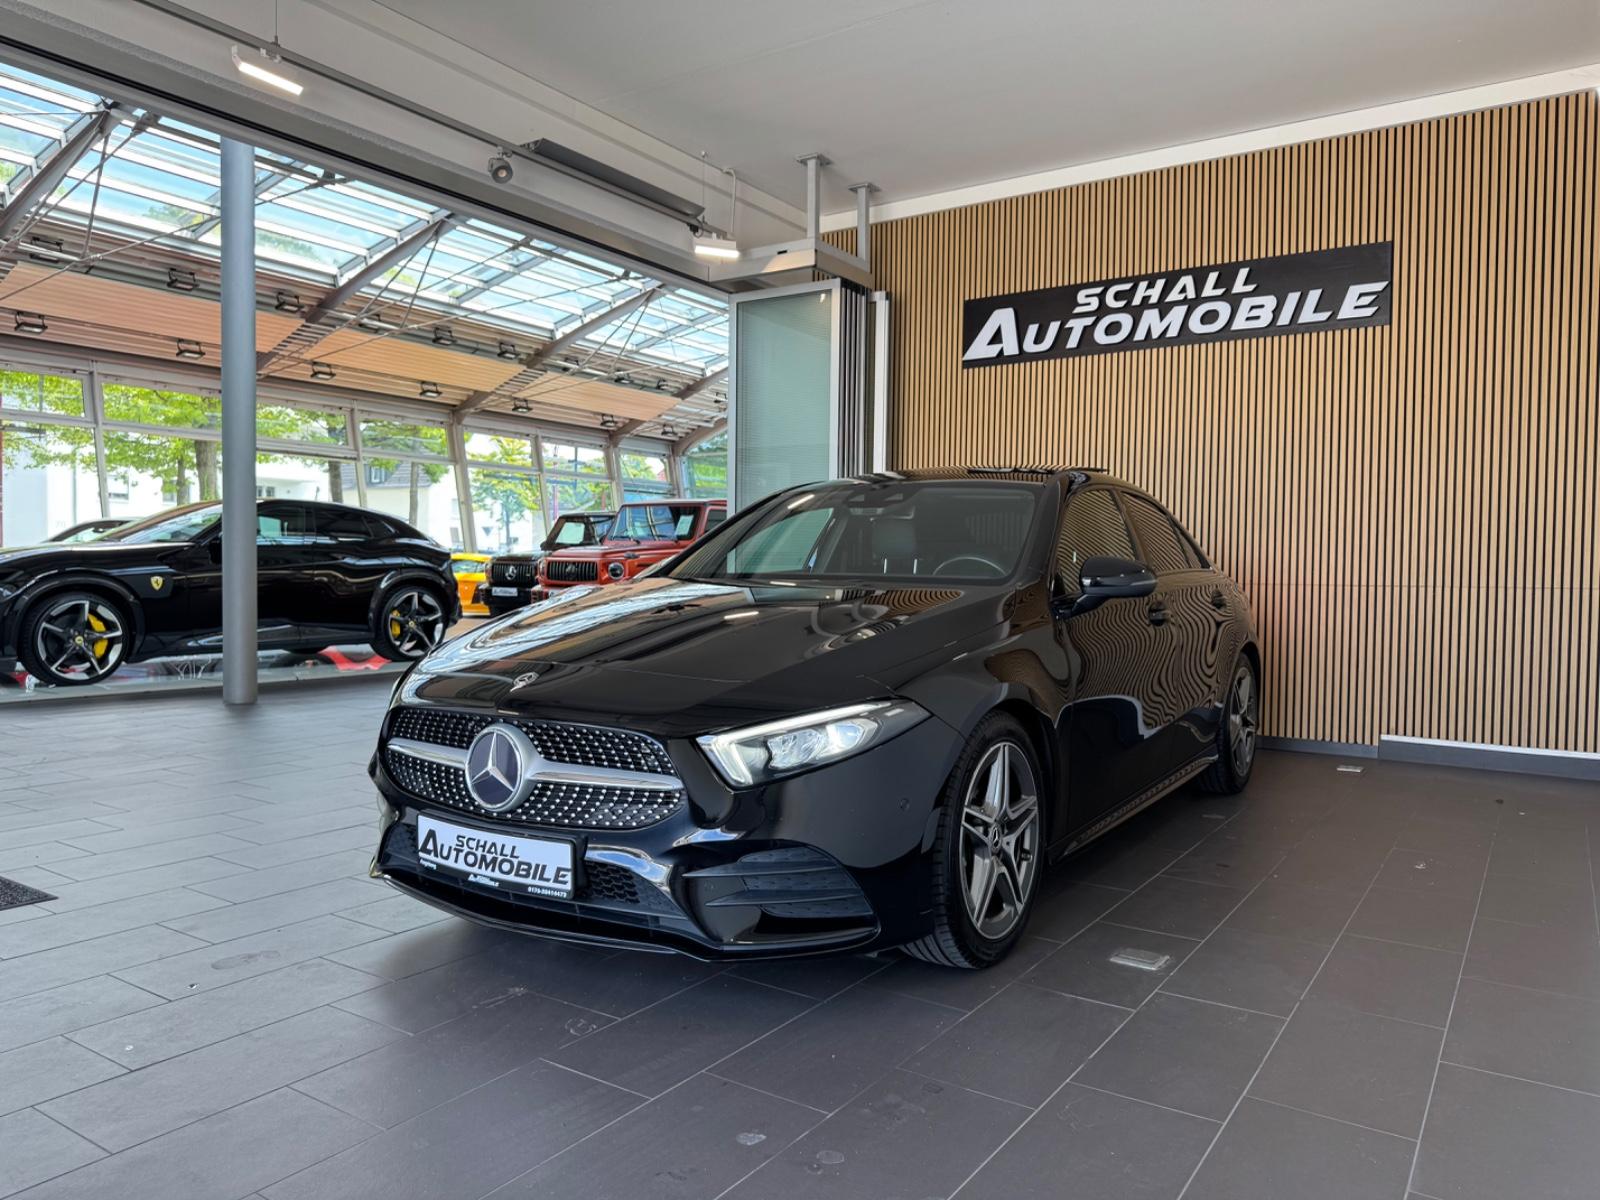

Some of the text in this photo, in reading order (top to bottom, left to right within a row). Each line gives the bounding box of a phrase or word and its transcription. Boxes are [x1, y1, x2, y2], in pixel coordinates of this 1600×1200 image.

[1073, 267, 1257, 314] SCHALL
[962, 280, 1389, 361] AUTOMOBILE
[419, 829, 571, 885] AUTOMOBILE
[456, 835, 520, 859] SCHALL
